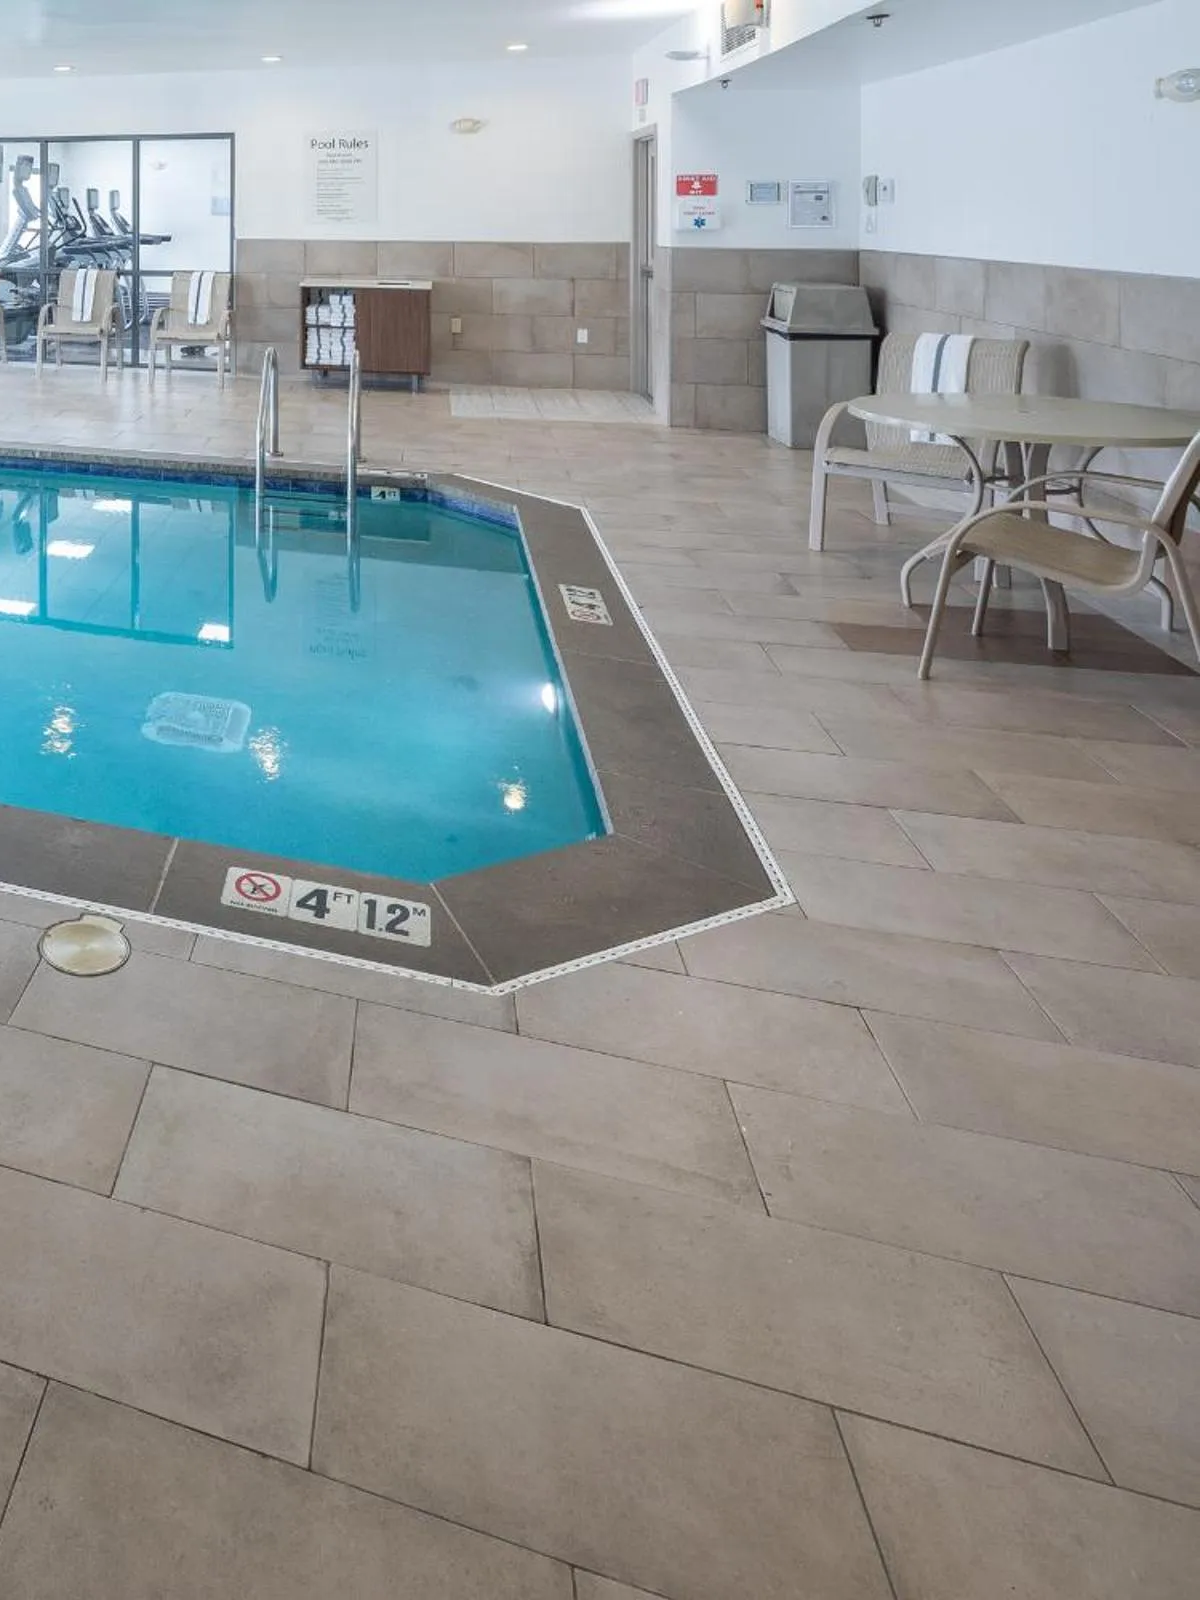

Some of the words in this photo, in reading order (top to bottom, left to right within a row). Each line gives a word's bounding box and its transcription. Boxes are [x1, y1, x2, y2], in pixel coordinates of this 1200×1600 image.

[311, 138, 335, 150] Pool
[339, 138, 369, 149] Rules
[296, 888, 331, 920] 4
[333, 891, 354, 905] FT
[412, 906, 427, 918] M
